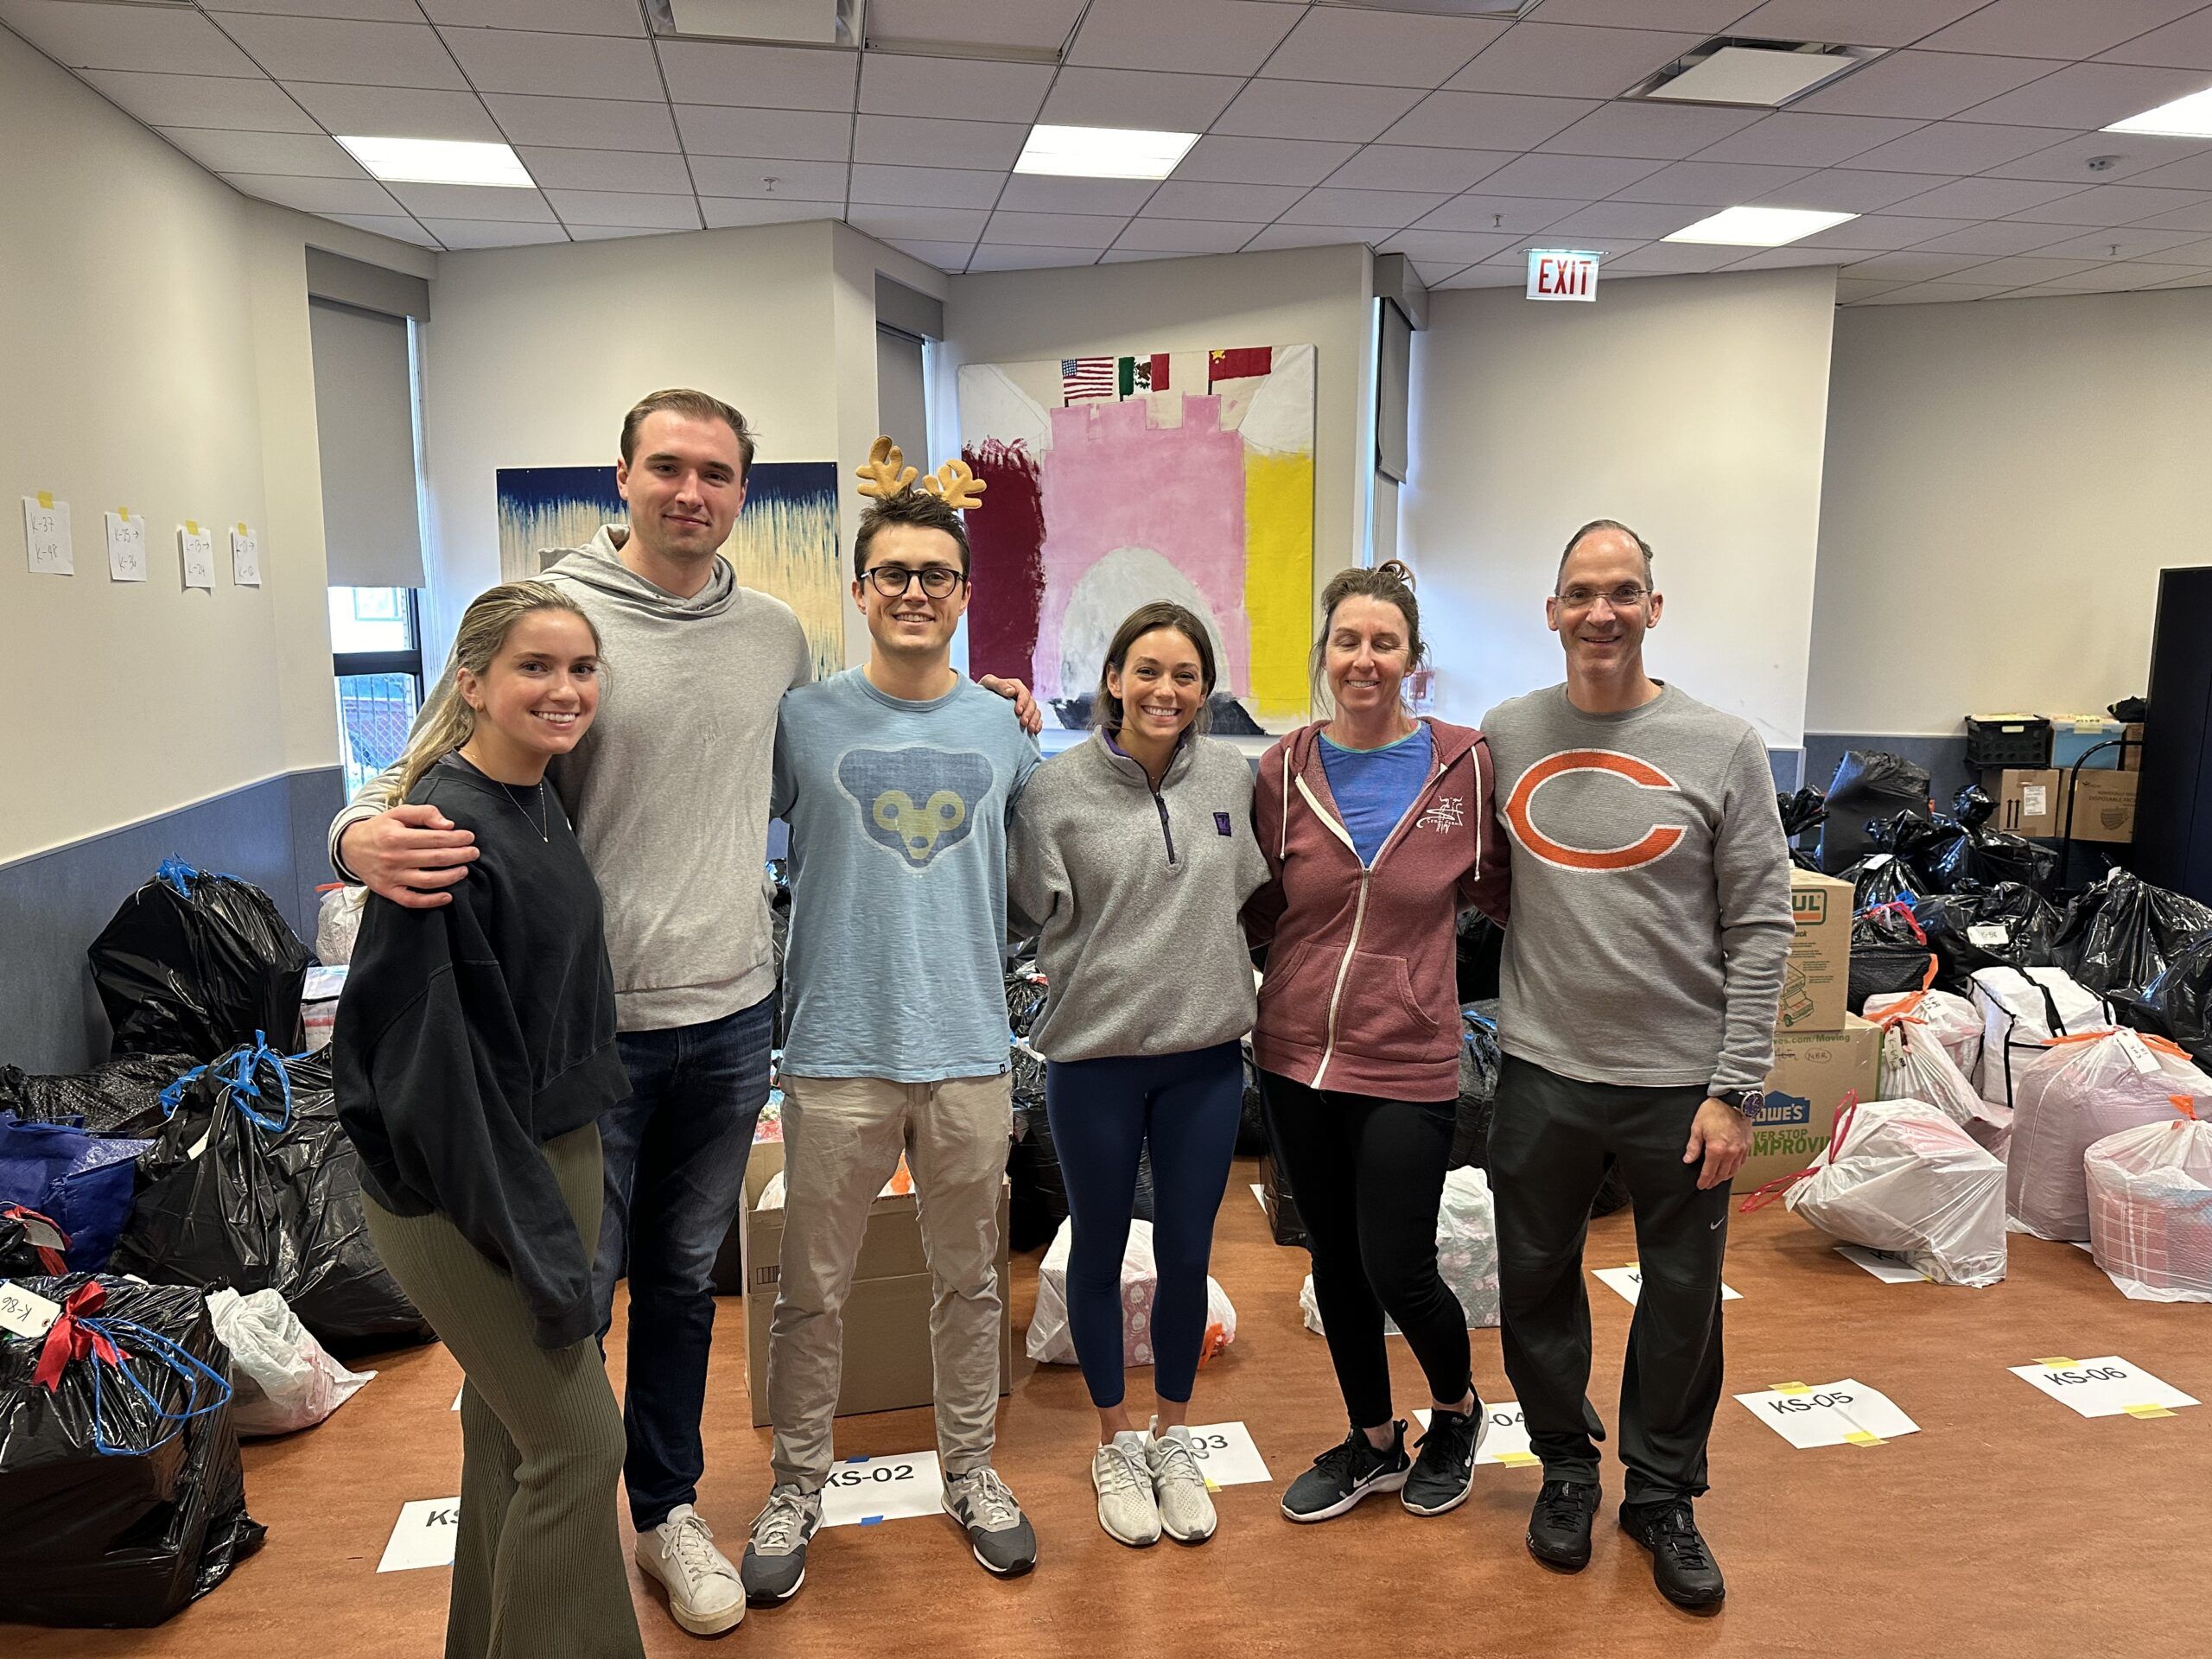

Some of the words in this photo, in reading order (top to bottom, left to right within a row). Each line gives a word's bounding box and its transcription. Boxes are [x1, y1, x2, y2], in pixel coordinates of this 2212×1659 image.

[1538, 258, 1592, 295] EXIT
[1503, 748, 1688, 873] C
[1792, 895, 1821, 912] UL
[1752, 1103, 1803, 1122] OWE'S
[1752, 1130, 1777, 1142] VER
[1778, 1128, 1808, 1141] STOP
[1748, 1135, 1831, 1157] MPROVI
[1, 1296, 33, 1322] K-86
[2043, 1367, 2127, 1386] KS-06
[1767, 1392, 1854, 1414] KS-05
[1488, 1412, 1525, 1427] -04
[1191, 1434, 1229, 1449] 03
[824, 1465, 915, 1488] KS-02
